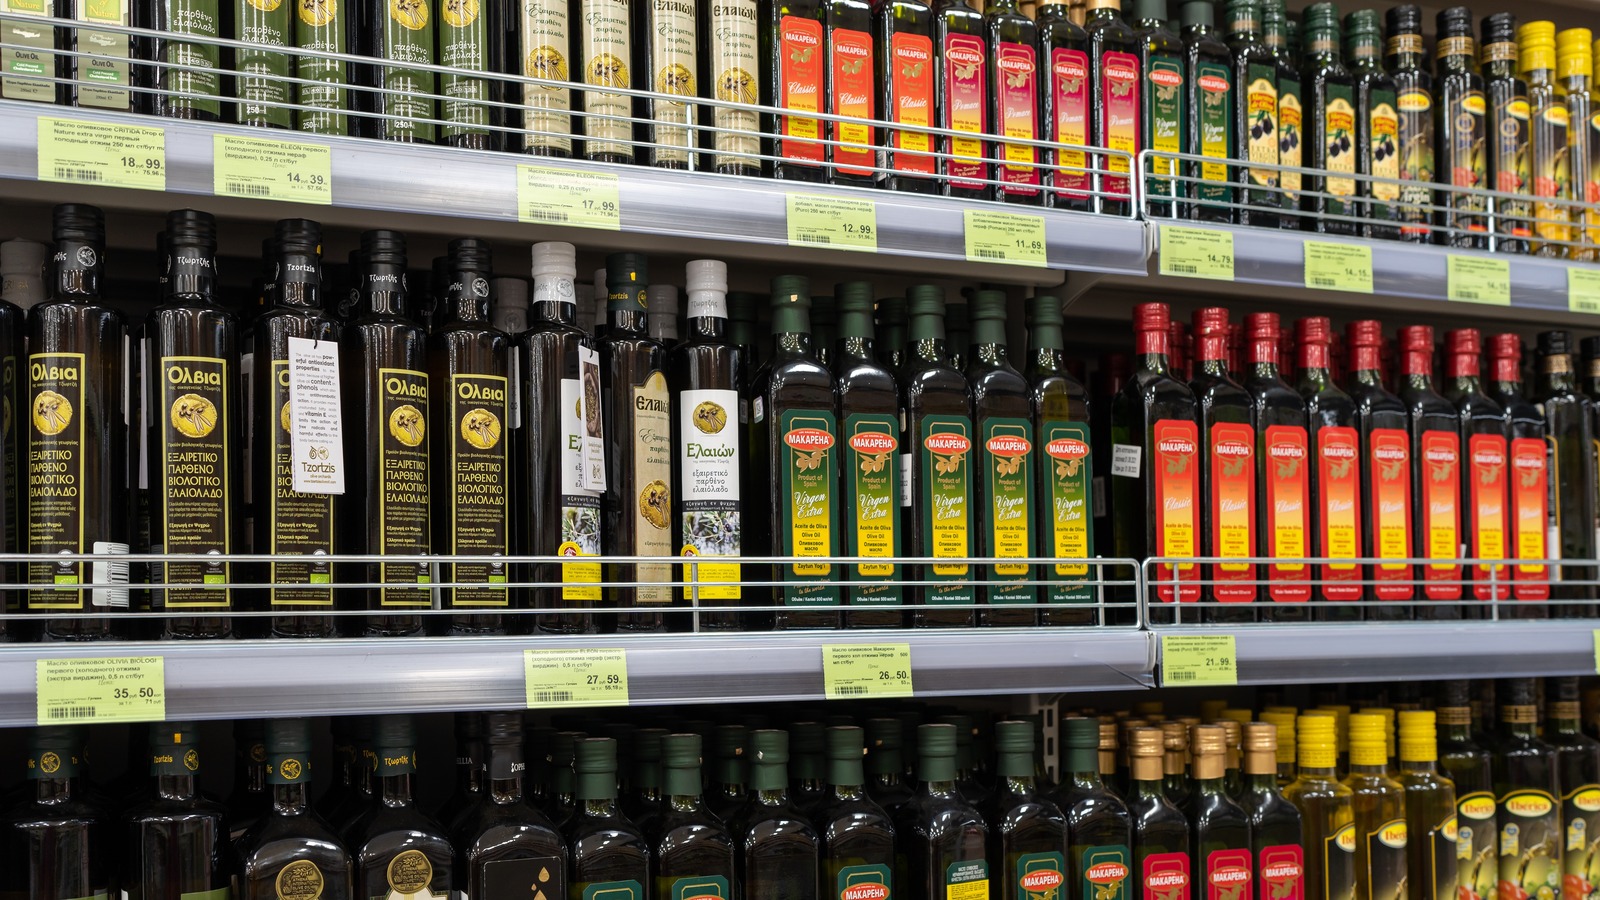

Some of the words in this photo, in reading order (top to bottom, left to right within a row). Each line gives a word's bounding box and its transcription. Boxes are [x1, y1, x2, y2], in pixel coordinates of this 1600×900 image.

[12, 0, 40, 9] Nature
[90, 5, 117, 19] Nature
[177, 8, 212, 23] παρθένο
[173, 18, 215, 34] ελαιόλαδο
[786, 33, 817, 45] МАКАРЕНА
[837, 45, 868, 56] МАКАРЕНА
[897, 48, 927, 60] МАКАРЕНА
[950, 51, 980, 62] МАКАРЕНА
[1002, 61, 1031, 70] МАКАРЕНА
[1056, 66, 1084, 77] МАКАРЕНА
[1107, 68, 1134, 79] МАКАРЕНА
[788, 82, 817, 94] Classic
[839, 93, 867, 105] Classic
[900, 96, 928, 108] Classic
[121, 157, 135, 167] 18
[146, 159, 160, 169] 99
[287, 172, 300, 182] 14
[310, 175, 324, 185] 39
[582, 200, 593, 209] 17
[602, 201, 614, 211] 99
[843, 224, 853, 232] 12
[860, 225, 870, 234] 99
[1016, 240, 1024, 248] 11
[1032, 241, 1041, 249] 69
[287, 263, 315, 273] Tzortzis
[789, 435, 828, 444] МАКАРЕНА
[854, 439, 892, 448] МАКАРЕНА
[928, 439, 966, 449] МАКАРЕНА
[687, 443, 734, 458] Ελαιών
[990, 442, 1026, 451] МАКАРЕНА
[1050, 445, 1084, 454] МАКАРЕНА
[1160, 443, 1193, 452] МАКАРЕНА
[1217, 445, 1248, 455] МАКАРЕНА
[1271, 447, 1303, 456] МАКАРЕНА
[1324, 447, 1354, 457] МАКАРЕНА
[168, 452, 217, 462] ΕΞΑΙΡΕΤΙΚΟ
[169, 464, 214, 474] ΠΑΡΘΕΝΟ
[302, 462, 335, 473] Tzortzis
[386, 460, 425, 471] ΕΞΑΙΡΕΤΙΚΟ
[457, 463, 501, 472] ΕΞΑΙΡΕΤΙΚΟ
[386, 471, 424, 481] ΠΑΡΘΕΝΟ
[458, 473, 497, 483] ΠΑΡΘΕΝΟ
[693, 470, 728, 478] εξαιρετικό
[169, 477, 220, 486] ΒΙΟΛΟΓΙΚΟ
[696, 478, 725, 486] παρθένο
[386, 482, 427, 493] ΒΙΟΛΟΓΙΚΟ
[458, 484, 502, 494] ΒΙΟΛΟΓΙΚΟ
[692, 485, 728, 493] ελαιόλαδο
[169, 489, 222, 498] ΕΛΑΙΟΛΑΔΟ
[387, 494, 428, 504] ΕΛΑΙΟΛΑΔΟ
[794, 491, 826, 505] Virgen
[458, 495, 504, 505] ΕΛΑΙΟΛΑΔΟ
[859, 494, 890, 508] Virgen
[934, 494, 964, 507] Virgen
[996, 495, 1024, 508] Virgen
[1056, 497, 1083, 510] Virgen
[1165, 497, 1191, 511] Classic
[1221, 499, 1246, 512] Classic
[797, 505, 823, 519] Extra
[862, 508, 887, 521] Extra
[937, 507, 961, 520] Extra
[999, 508, 1022, 521] Extra
[1058, 510, 1080, 522] Extra
[1206, 658, 1214, 666] 21
[587, 675, 598, 684] 27
[607, 675, 619, 684] 59
[879, 671, 889, 679] 26
[897, 671, 906, 679] 50
[114, 688, 129, 699] 35
[139, 687, 153, 697] 50
[1510, 801, 1548, 811] Iberica
[1089, 867, 1124, 878] МАКАРЕНА
[1214, 872, 1246, 881] МАКАРЕНА
[1266, 867, 1298, 876] МАКАРЕНА
[1024, 875, 1059, 886] МАКАРЕНА
[1150, 876, 1184, 885] МАКАРЕНА
[845, 888, 884, 900] МАКАРЕНА
